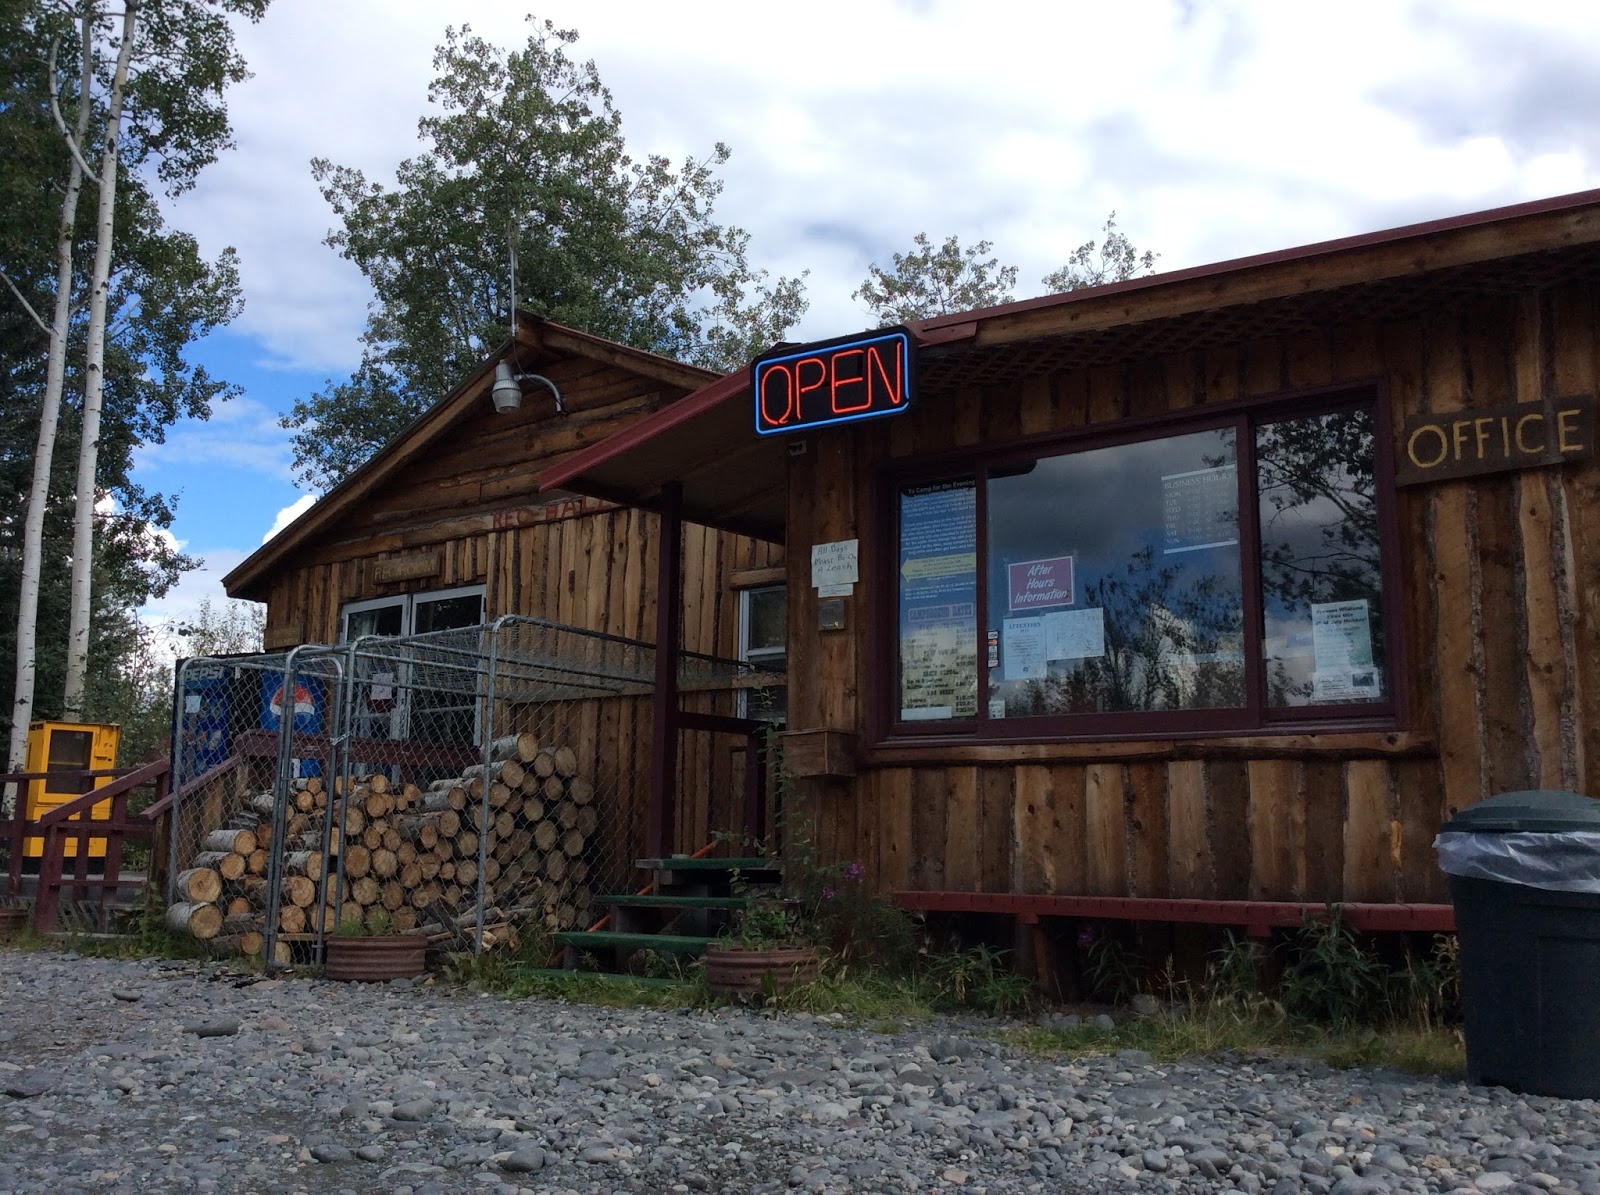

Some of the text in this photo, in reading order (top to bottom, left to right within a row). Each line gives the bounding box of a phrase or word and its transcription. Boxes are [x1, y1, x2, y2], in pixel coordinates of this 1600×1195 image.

[761, 342, 902, 425] OPEN
[1407, 409, 1584, 469] OFFICE
[1164, 472, 1232, 490] BUSINESS HOURS
[915, 486, 932, 494] Camp
[814, 558, 834, 566] Must
[826, 562, 853, 572] Leash
[1027, 565, 1054, 577] After
[1026, 579, 1056, 590] Hours
[1014, 590, 1068, 604] Information
[184, 667, 225, 682] PEPSI
